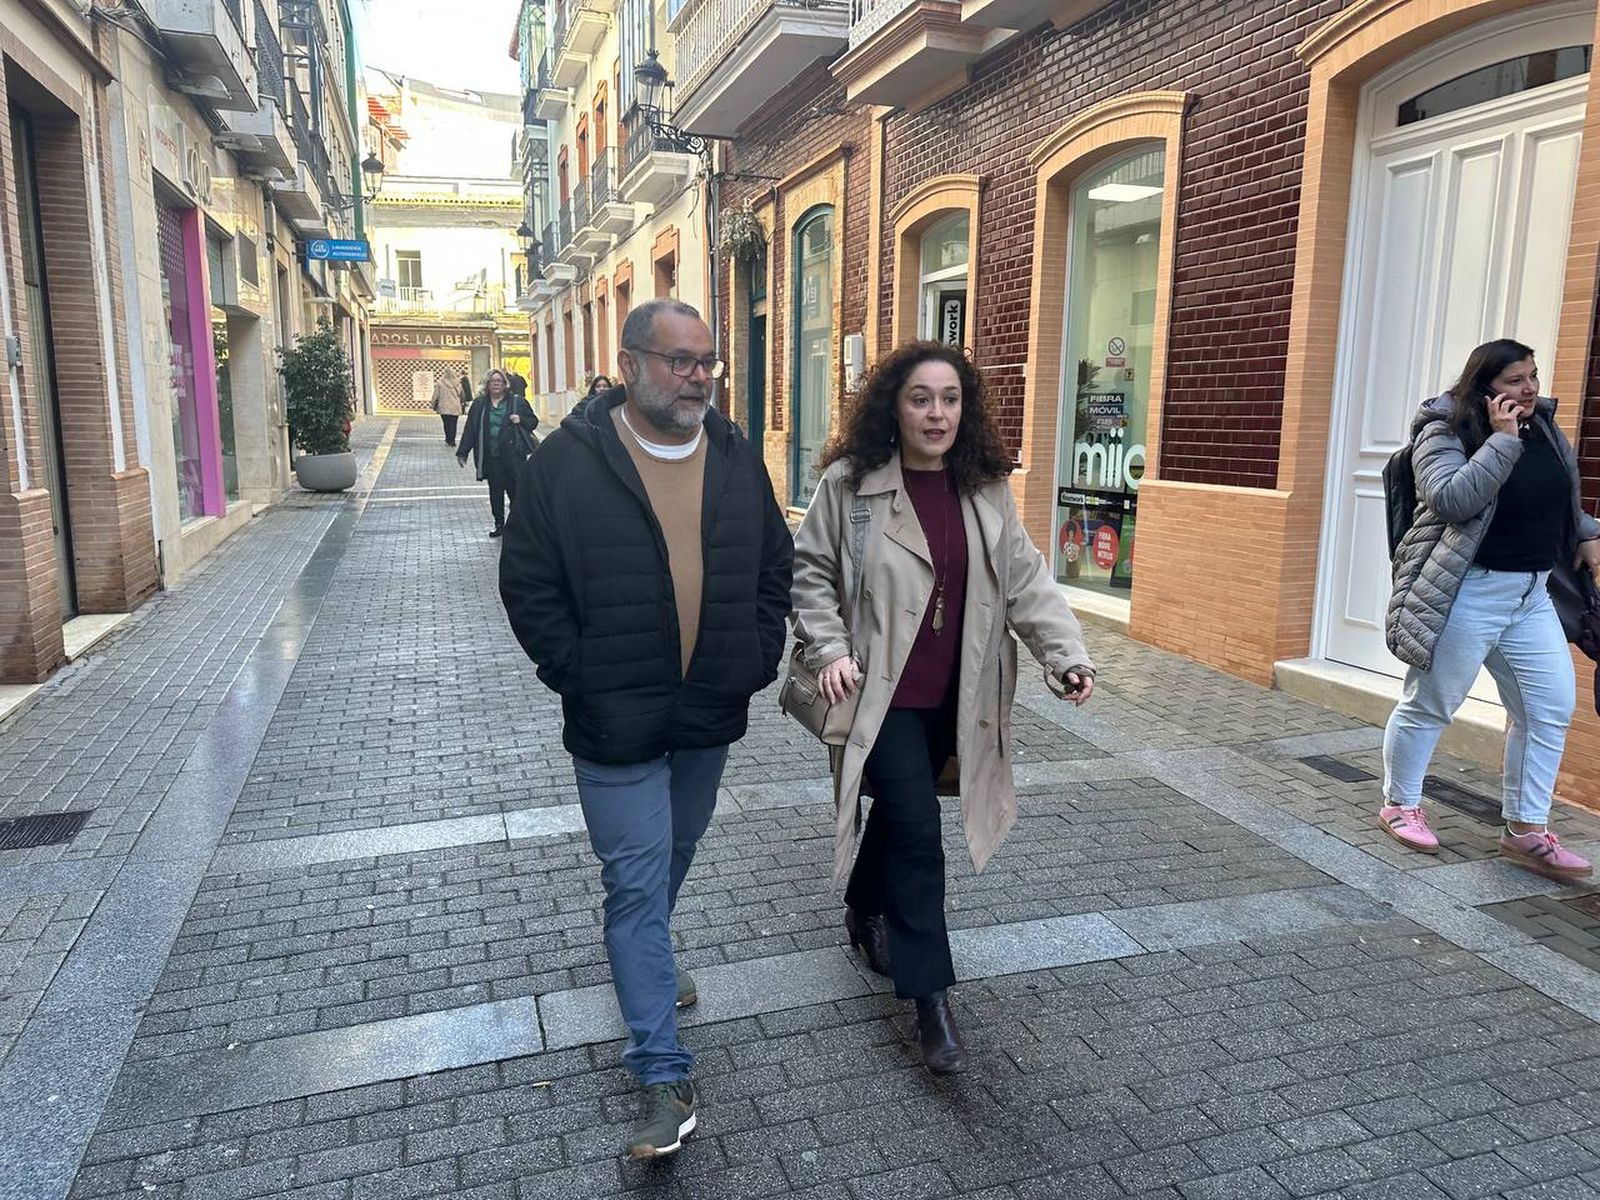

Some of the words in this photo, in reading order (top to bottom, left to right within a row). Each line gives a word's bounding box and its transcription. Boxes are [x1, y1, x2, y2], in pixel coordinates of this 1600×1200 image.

[416, 334, 434, 345] LA
[440, 334, 489, 346] IBENSE
[1090, 395, 1122, 403] FIBRA
[1089, 405, 1121, 414] MÓVIL
